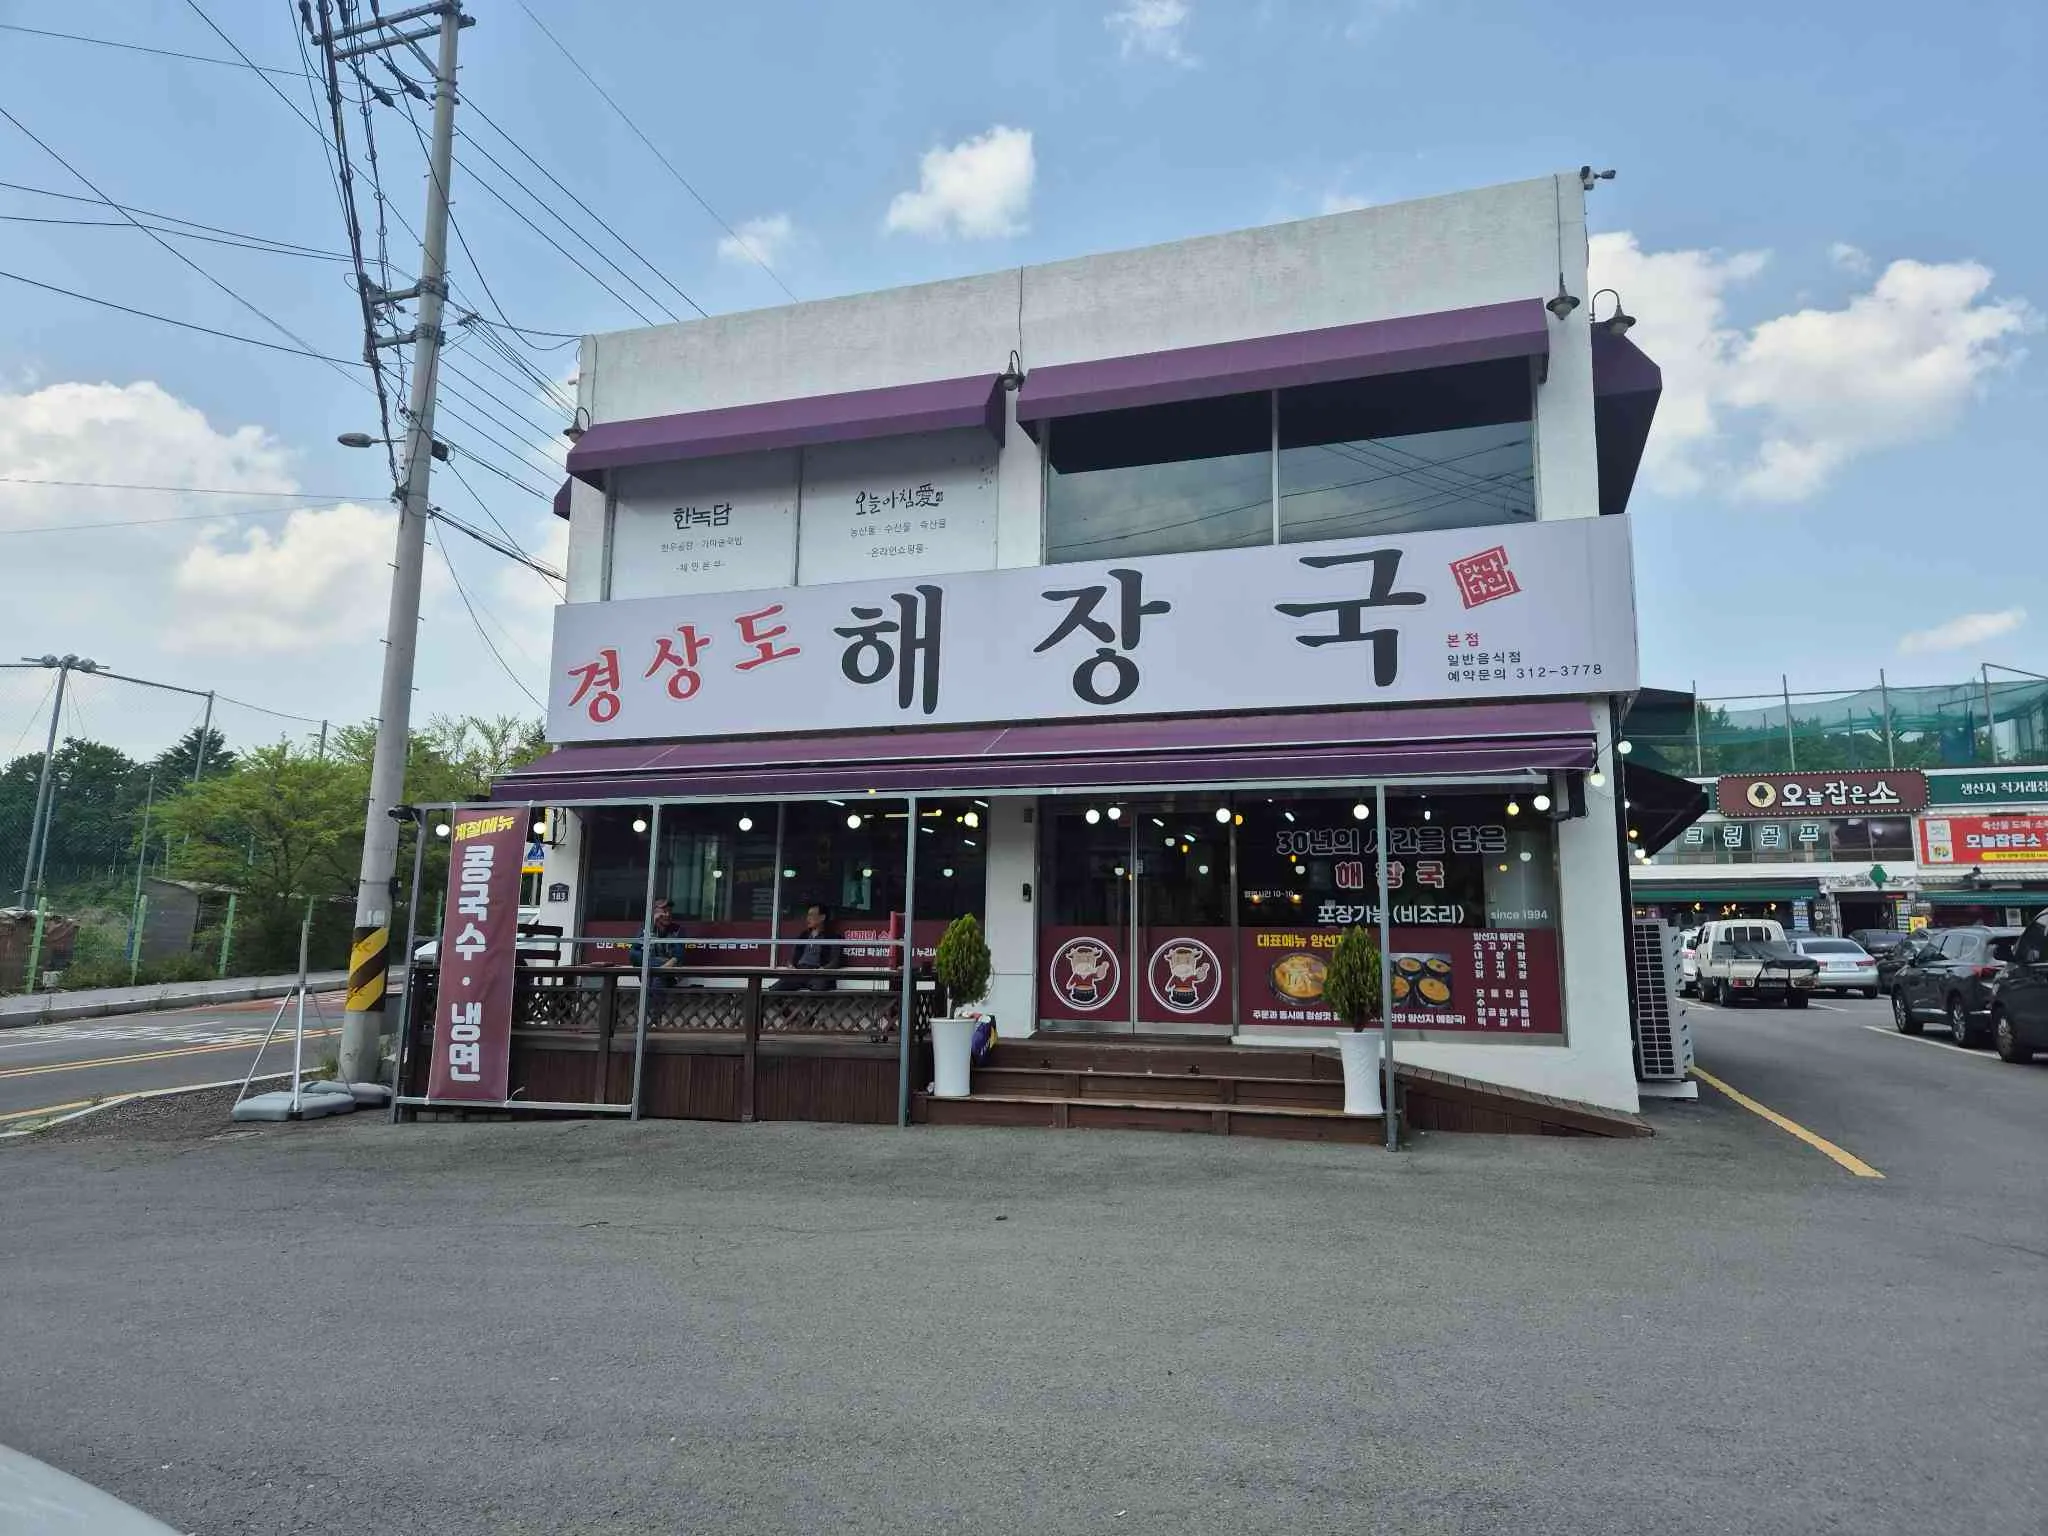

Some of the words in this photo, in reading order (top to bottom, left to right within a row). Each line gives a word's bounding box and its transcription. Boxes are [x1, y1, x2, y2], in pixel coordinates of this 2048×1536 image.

[568, 604, 801, 723] 경상도
[833, 548, 1427, 715] 해장국
[1446, 632, 1481, 647] 본점
[1447, 651, 1521, 666] 일반음식점
[1447, 669, 1507, 682] 예약문의
[1516, 664, 1602, 679] 312-3778
[1781, 780, 1900, 807] 오늘잡은소
[1960, 782, 1996, 795] 생산자
[1276, 829, 1360, 855] 30년의
[456, 845, 495, 960] 콩국수
[1392, 904, 1464, 924] (비조리)
[1490, 911, 1520, 920] since
[1256, 934, 1307, 948] 대표메뉴
[450, 1001, 481, 1082] 냉면
